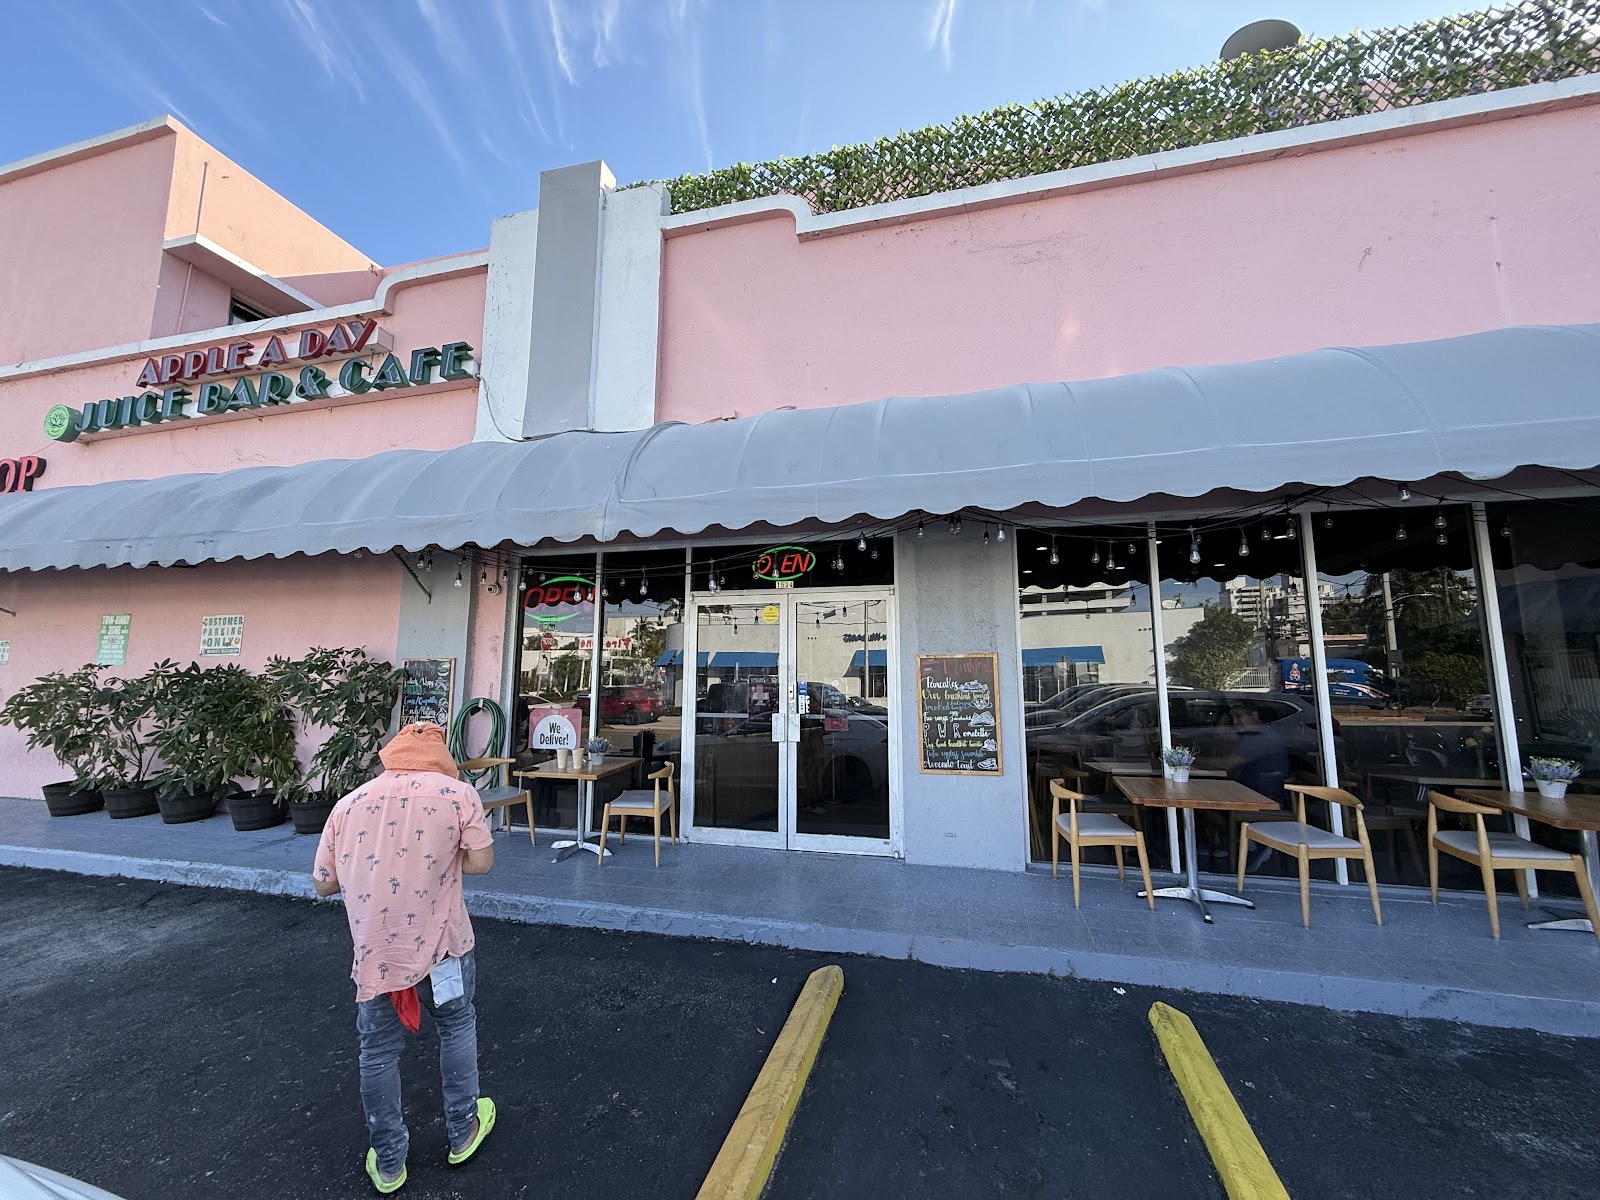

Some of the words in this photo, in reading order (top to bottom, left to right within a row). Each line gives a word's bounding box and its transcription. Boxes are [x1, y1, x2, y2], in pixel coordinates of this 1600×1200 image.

[136, 341, 254, 388] APPLE
[259, 335, 289, 367] A
[299, 318, 377, 361] DAY
[74, 388, 192, 433] JUICE
[197, 372, 293, 414] BAR
[296, 365, 333, 401] &
[339, 341, 474, 394] CAFE
[102, 615, 130, 625] TOW-AWAY
[204, 617, 243, 626] CUSTOMER
[203, 627, 242, 636] PARKING
[207, 637, 234, 647] ONLY
[549, 722, 561, 734] We
[540, 733, 569, 746] Deliver!
